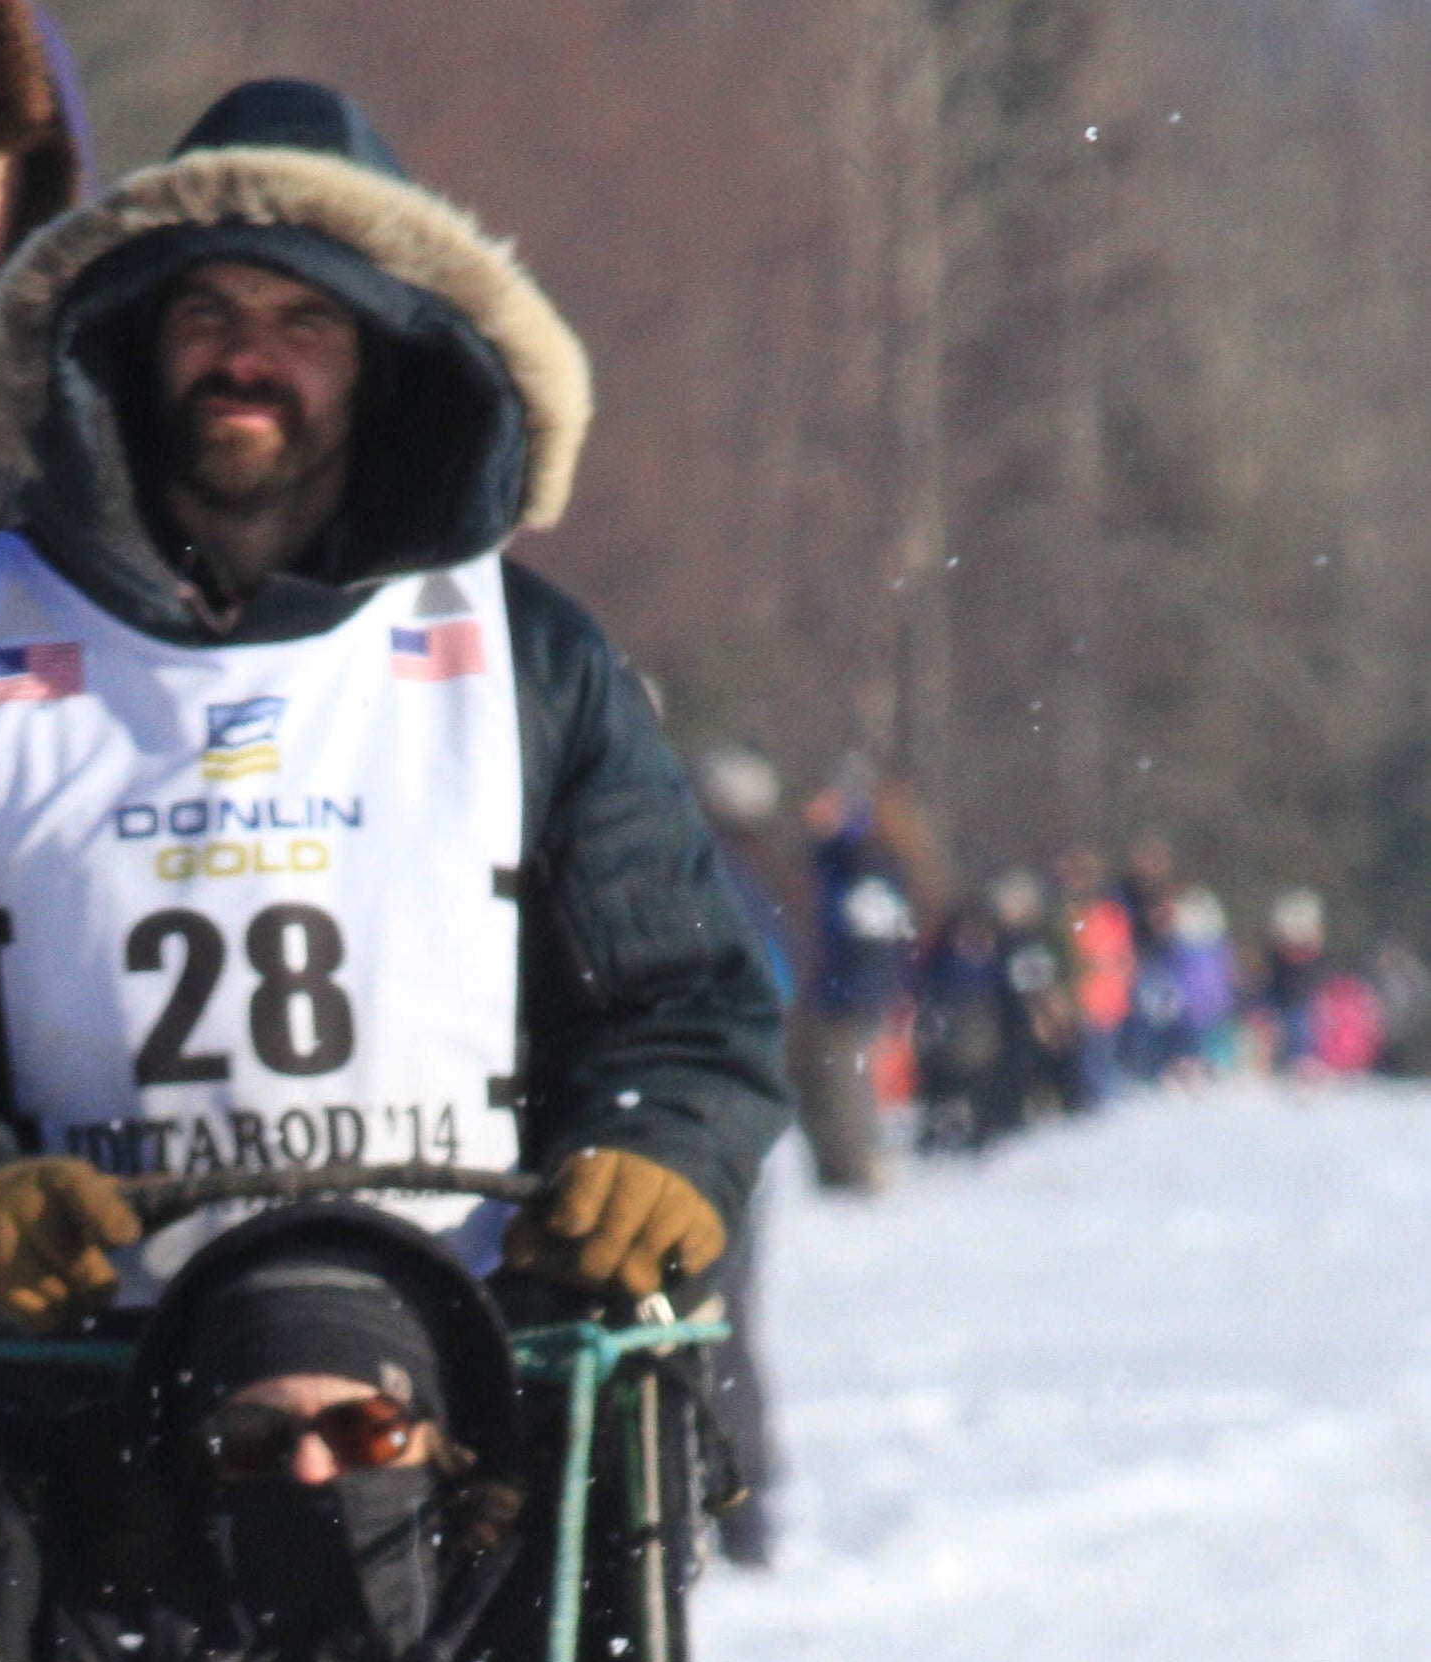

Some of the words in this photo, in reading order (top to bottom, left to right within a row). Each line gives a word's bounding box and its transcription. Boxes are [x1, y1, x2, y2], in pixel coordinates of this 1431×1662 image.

[116, 795, 364, 840] DONLIN
[156, 838, 329, 882] GOLD
[124, 902, 355, 1087] 28
[384, 1102, 460, 1166] '14
